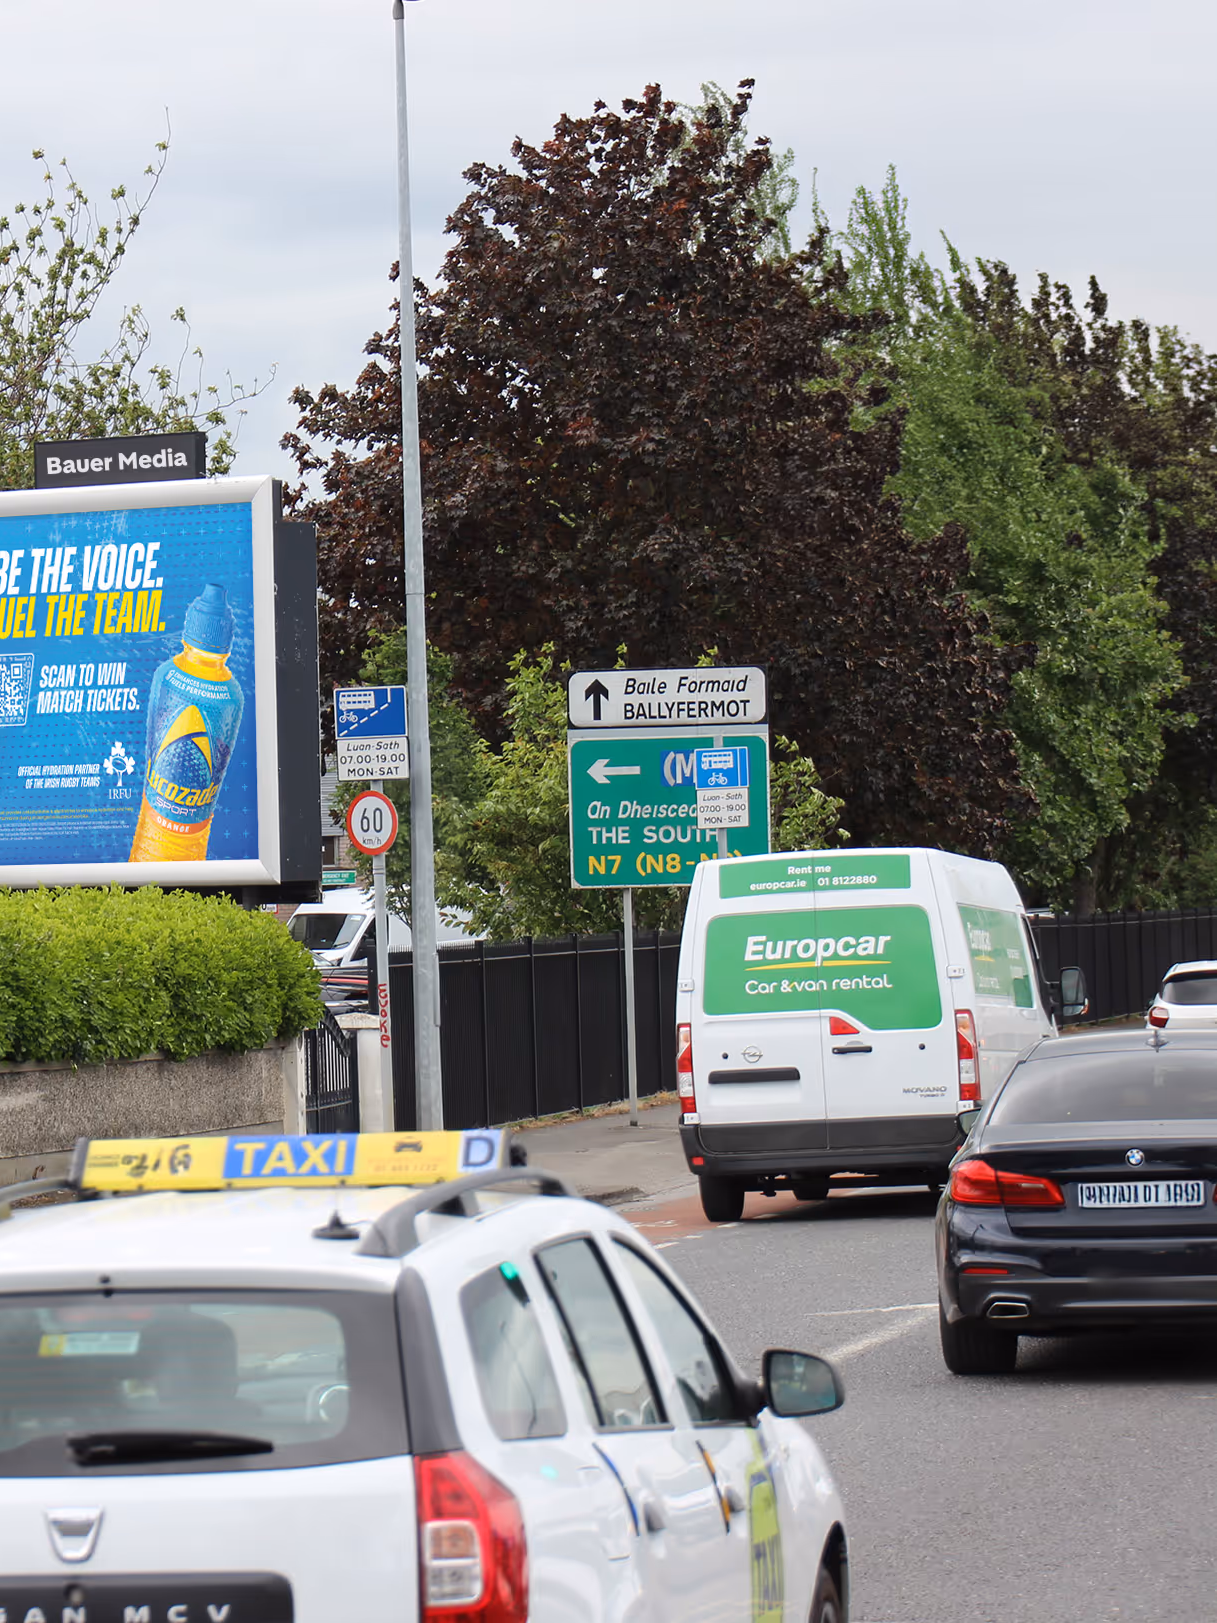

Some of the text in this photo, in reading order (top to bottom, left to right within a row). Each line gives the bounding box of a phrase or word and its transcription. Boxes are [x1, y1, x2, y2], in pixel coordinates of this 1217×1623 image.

[46, 447, 188, 475] Bauer Media
[29, 546, 77, 594] THE
[82, 541, 164, 592] VOICE.
[44, 593, 88, 637] THE
[92, 589, 166, 636] TEAM.
[39, 662, 127, 689] SCAN TO WIN
[625, 675, 748, 695] Baile Formaid
[36, 687, 141, 714] MATCH TICKETS.
[624, 699, 751, 720] BALLYFERMOT
[340, 753, 406, 765] 07.00-19.00
[17, 763, 101, 777] OFFICIAL HYDRATION PARTNER
[25, 778, 34, 789] OF
[33, 777, 44, 789] THE
[60, 777, 80, 788] RUGBY
[80, 776, 101, 788] TEAMS
[146, 757, 219, 807] Lucozade
[108, 788, 132, 800] IRFU
[155, 796, 197, 817] SPORT
[157, 815, 191, 834] ORANGE
[360, 807, 383, 833] 60
[362, 836, 382, 846] km/h
[588, 826, 631, 844] THE
[588, 854, 622, 875] N7
[787, 864, 832, 875] Rent me
[749, 875, 878, 891] europcar.ie 01 8122880
[744, 934, 892, 967] Europcar
[745, 979, 777, 995] Car
[832, 973, 894, 990] rental
[234, 1139, 347, 1176] TAXI
[463, 1135, 496, 1168] D
[124, 1603, 232, 1623] MCV
